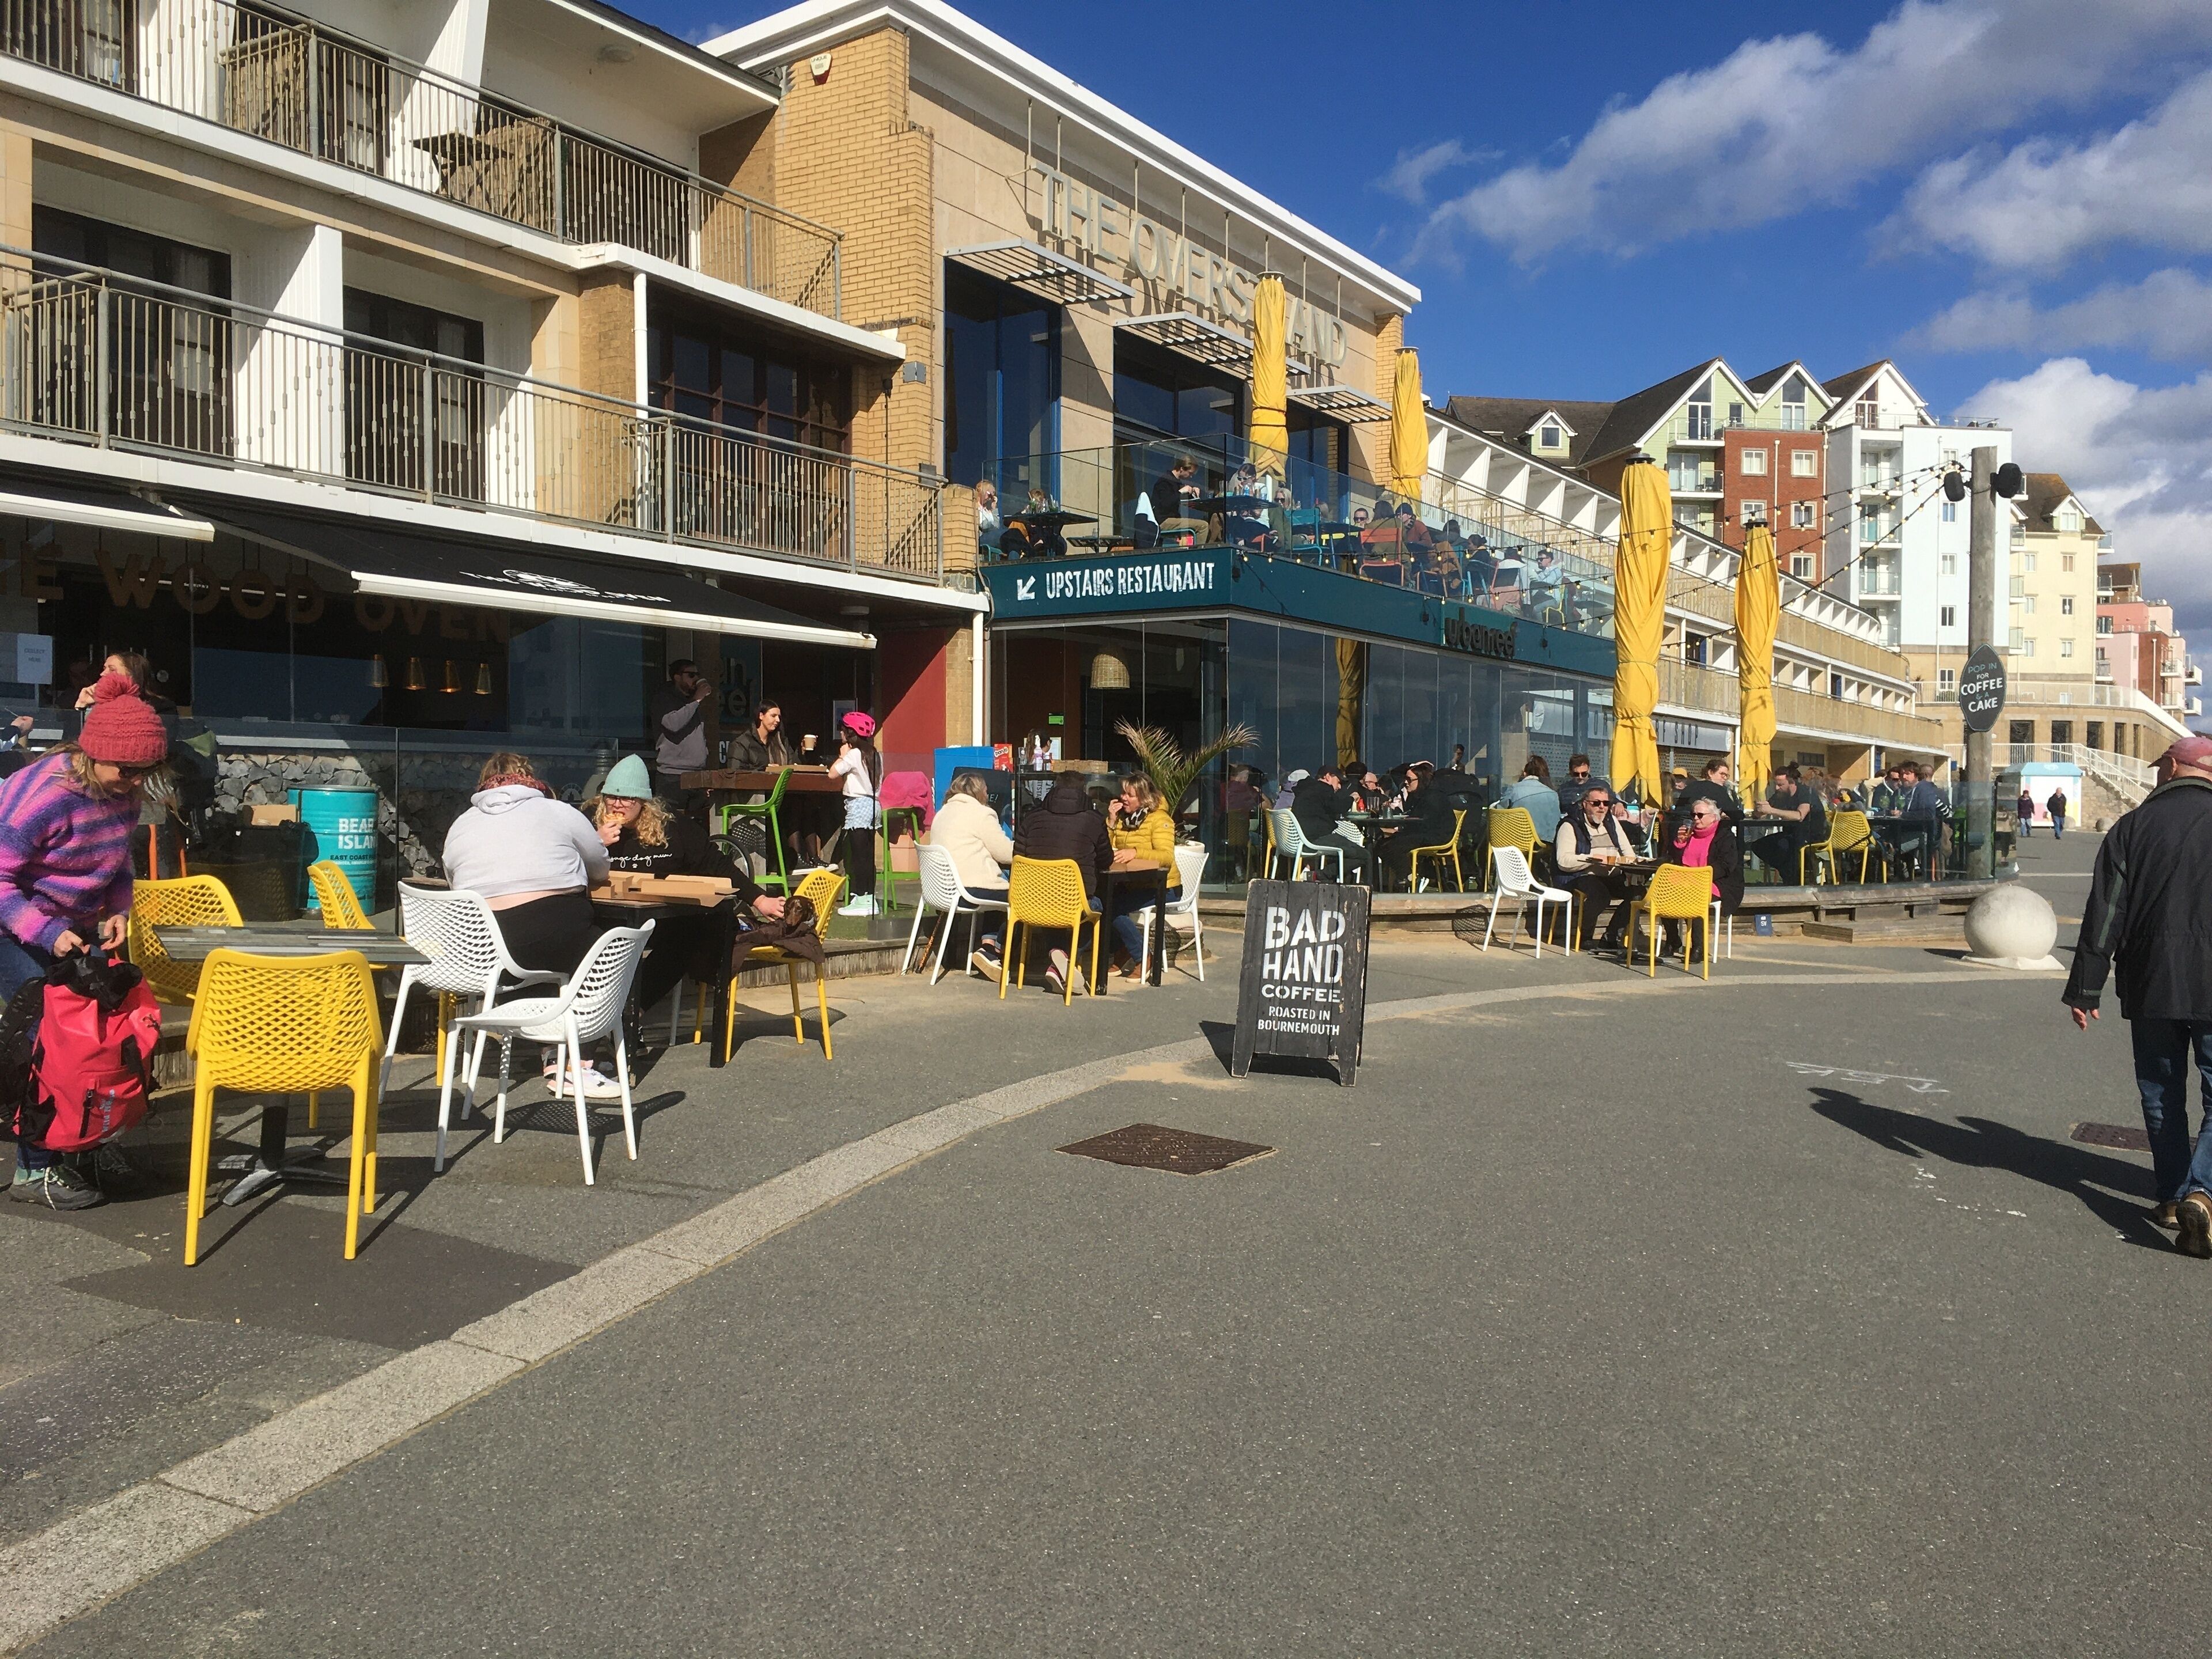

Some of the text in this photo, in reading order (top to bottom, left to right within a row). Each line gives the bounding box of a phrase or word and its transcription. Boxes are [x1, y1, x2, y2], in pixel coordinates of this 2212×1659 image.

[1030, 158, 1347, 367] THE OVERSAND
[94, 548, 324, 624] WOOD
[1046, 562, 1215, 599] UPSTAIRS RESTAURANT
[1968, 662, 1998, 674] POP IN
[1976, 672, 1989, 680] FOR
[1961, 677, 2003, 696] COFFEE
[1968, 697, 1998, 713] CAKE
[1675, 721, 1699, 747] SHOP
[632, 854, 652, 867] dog
[1264, 906, 1346, 949] BAD
[1263, 944, 1344, 984] HAND
[1261, 984, 1341, 1003] COFFEE
[1268, 1006, 1330, 1021] ROASTED IN
[1257, 1019, 1340, 1036] BOURNEMOUTH
